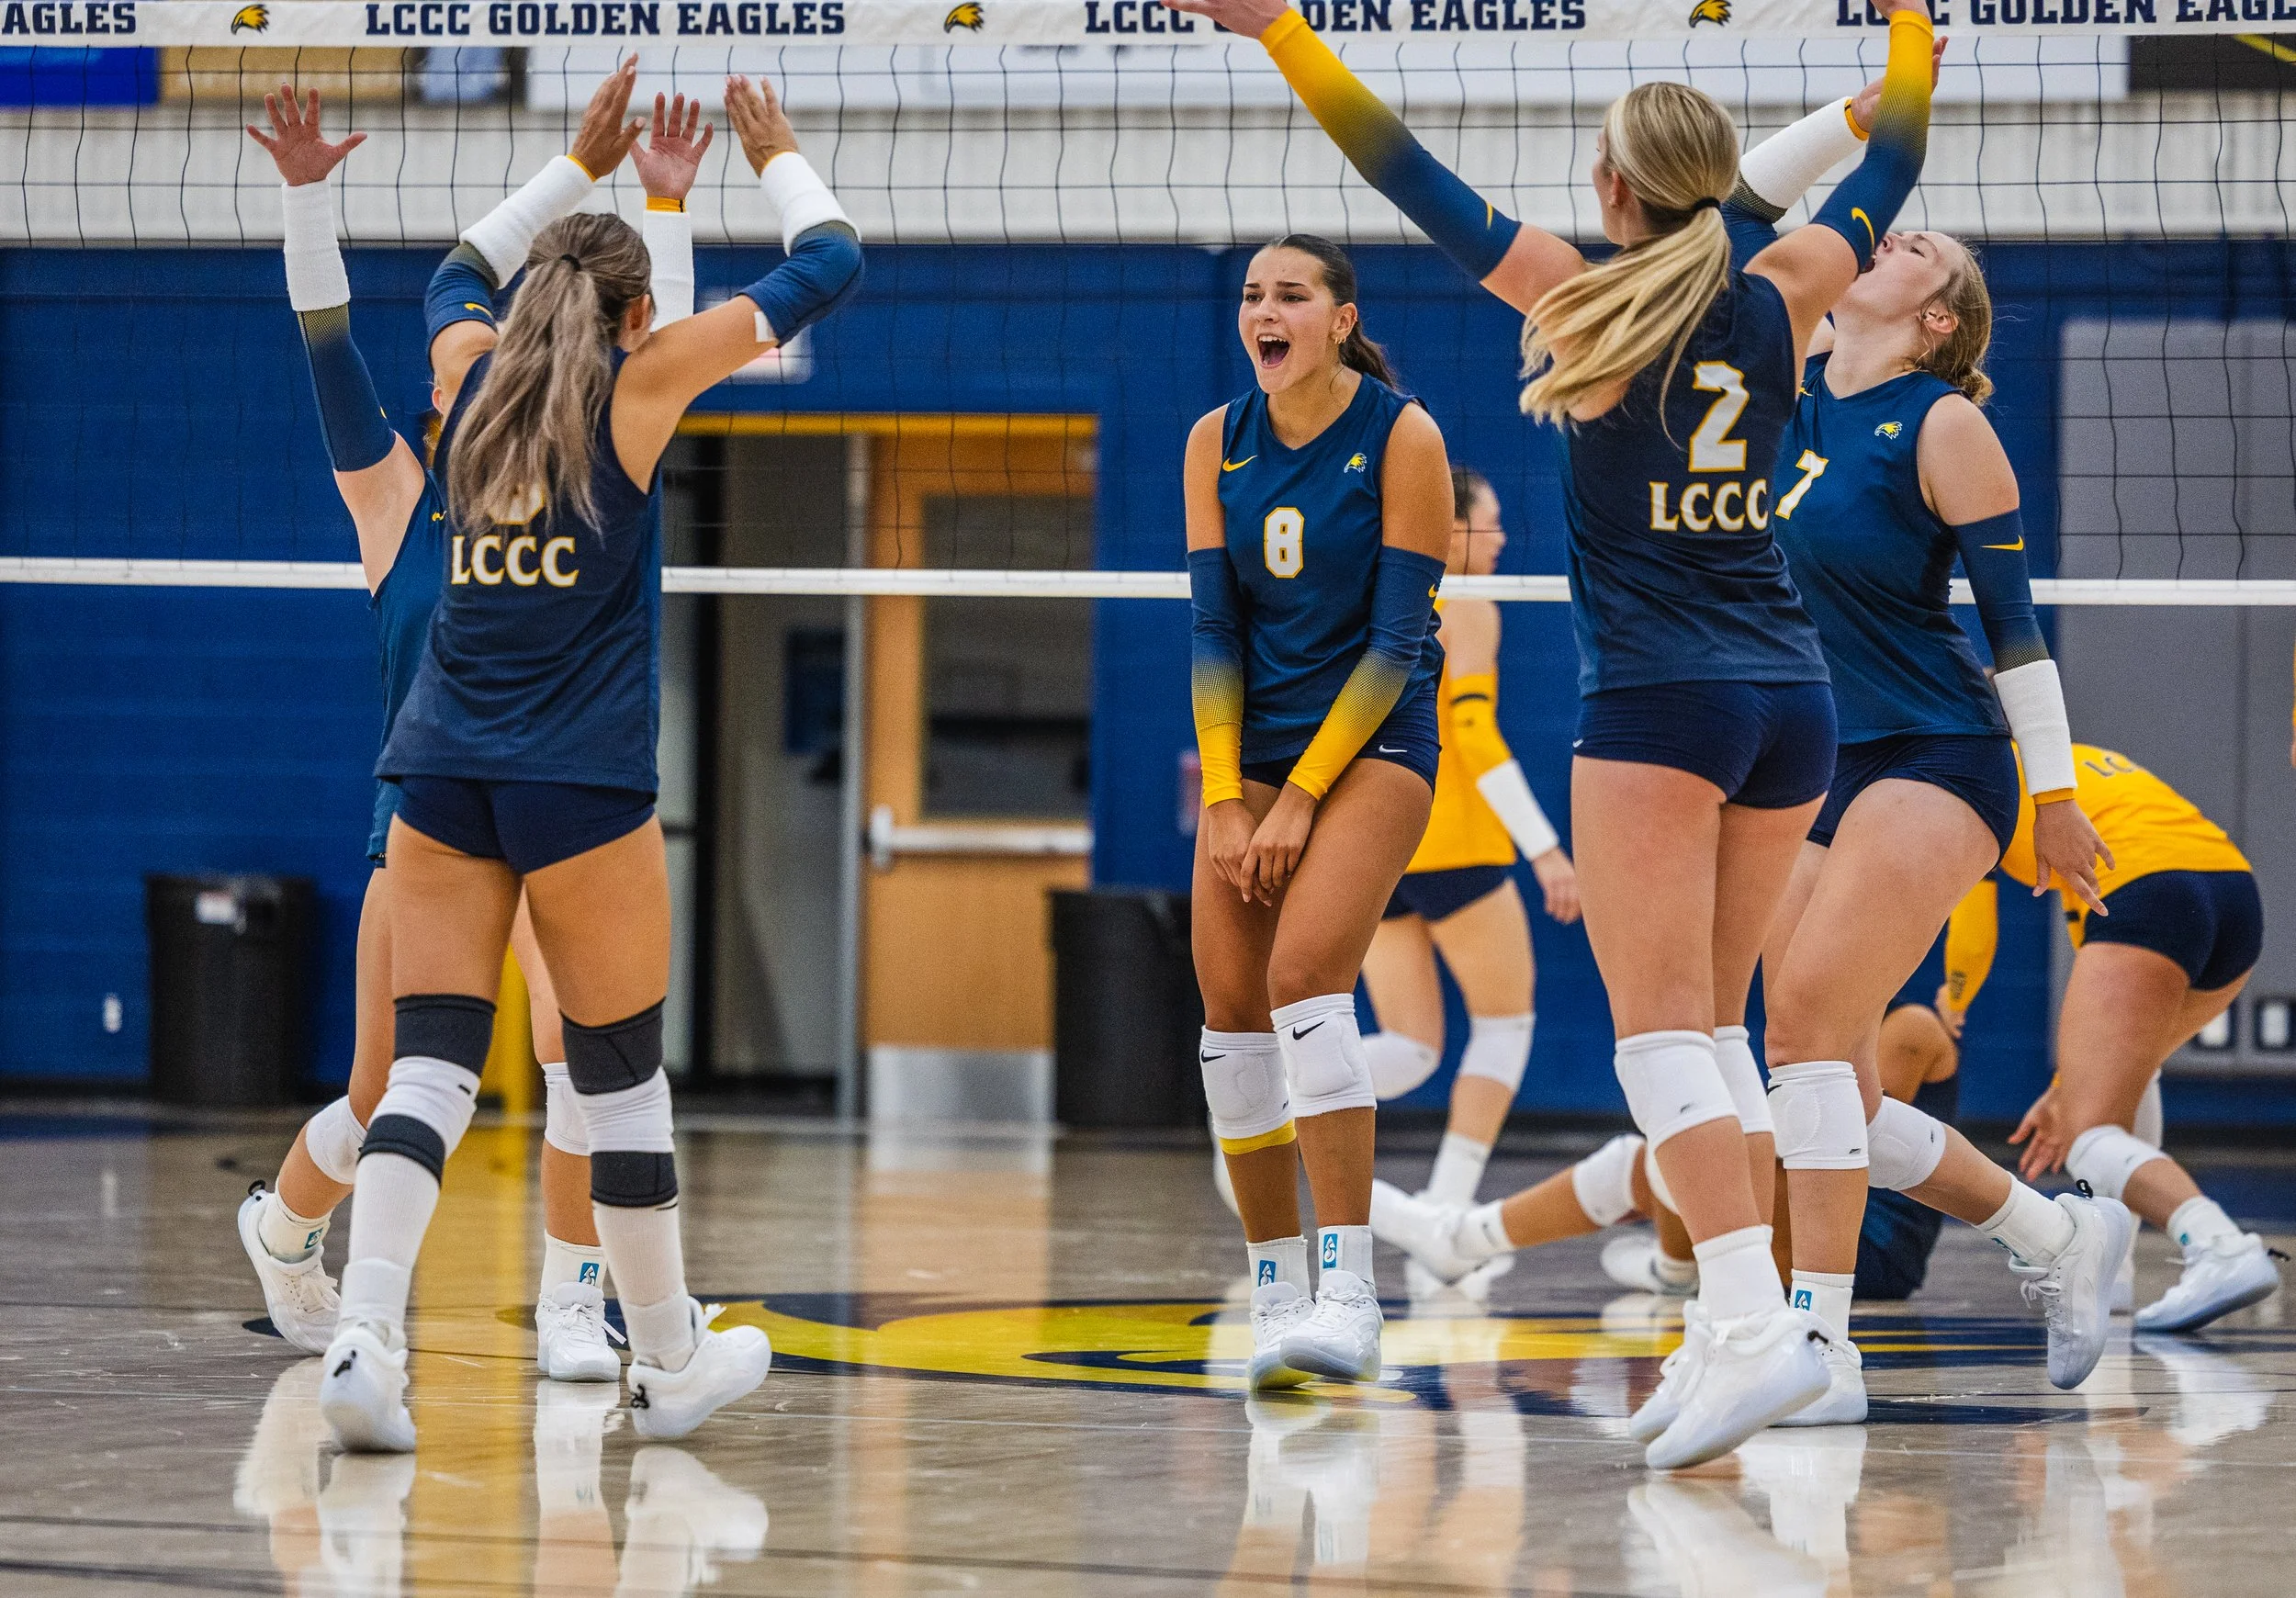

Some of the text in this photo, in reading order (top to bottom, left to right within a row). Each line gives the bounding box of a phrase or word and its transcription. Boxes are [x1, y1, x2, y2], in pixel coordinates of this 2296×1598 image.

[1, 2, 137, 35] AGLES
[366, 3, 845, 35] LCCC GOLDEN EAGLES
[1411, 0, 1586, 30] EAGLES
[1970, 0, 2156, 25] GOLDEN
[1688, 360, 1750, 472] 2
[1649, 478, 1769, 532] LCCC
[1775, 449, 1829, 520] 7
[451, 535, 580, 588] LCCC
[1264, 507, 1305, 579] 8
